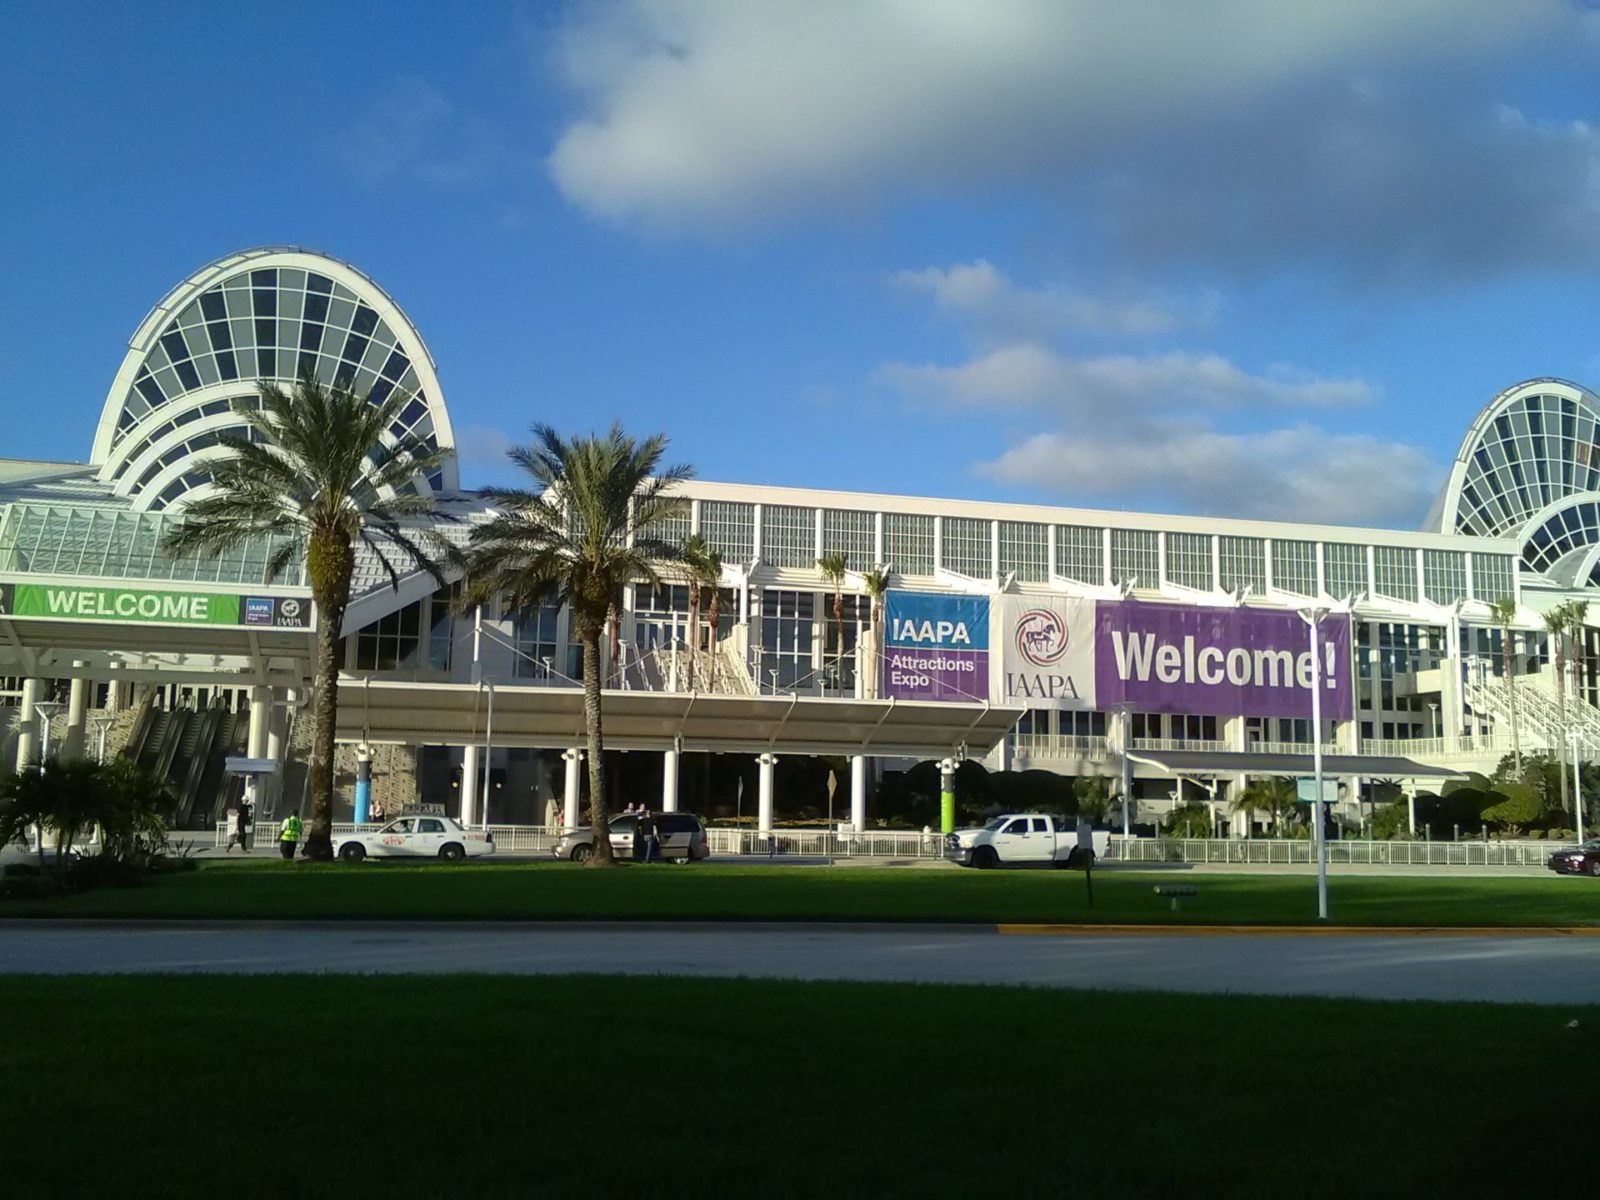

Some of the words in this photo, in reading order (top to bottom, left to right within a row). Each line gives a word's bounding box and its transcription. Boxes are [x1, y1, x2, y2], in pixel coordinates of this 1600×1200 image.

[47, 590, 209, 619] WELCOME
[892, 618, 971, 644] IAAPA
[891, 654, 974, 672] Attractions
[1111, 630, 1337, 689] Welcome!
[891, 671, 930, 689] Expo
[1006, 672, 1079, 700] IAAPA
